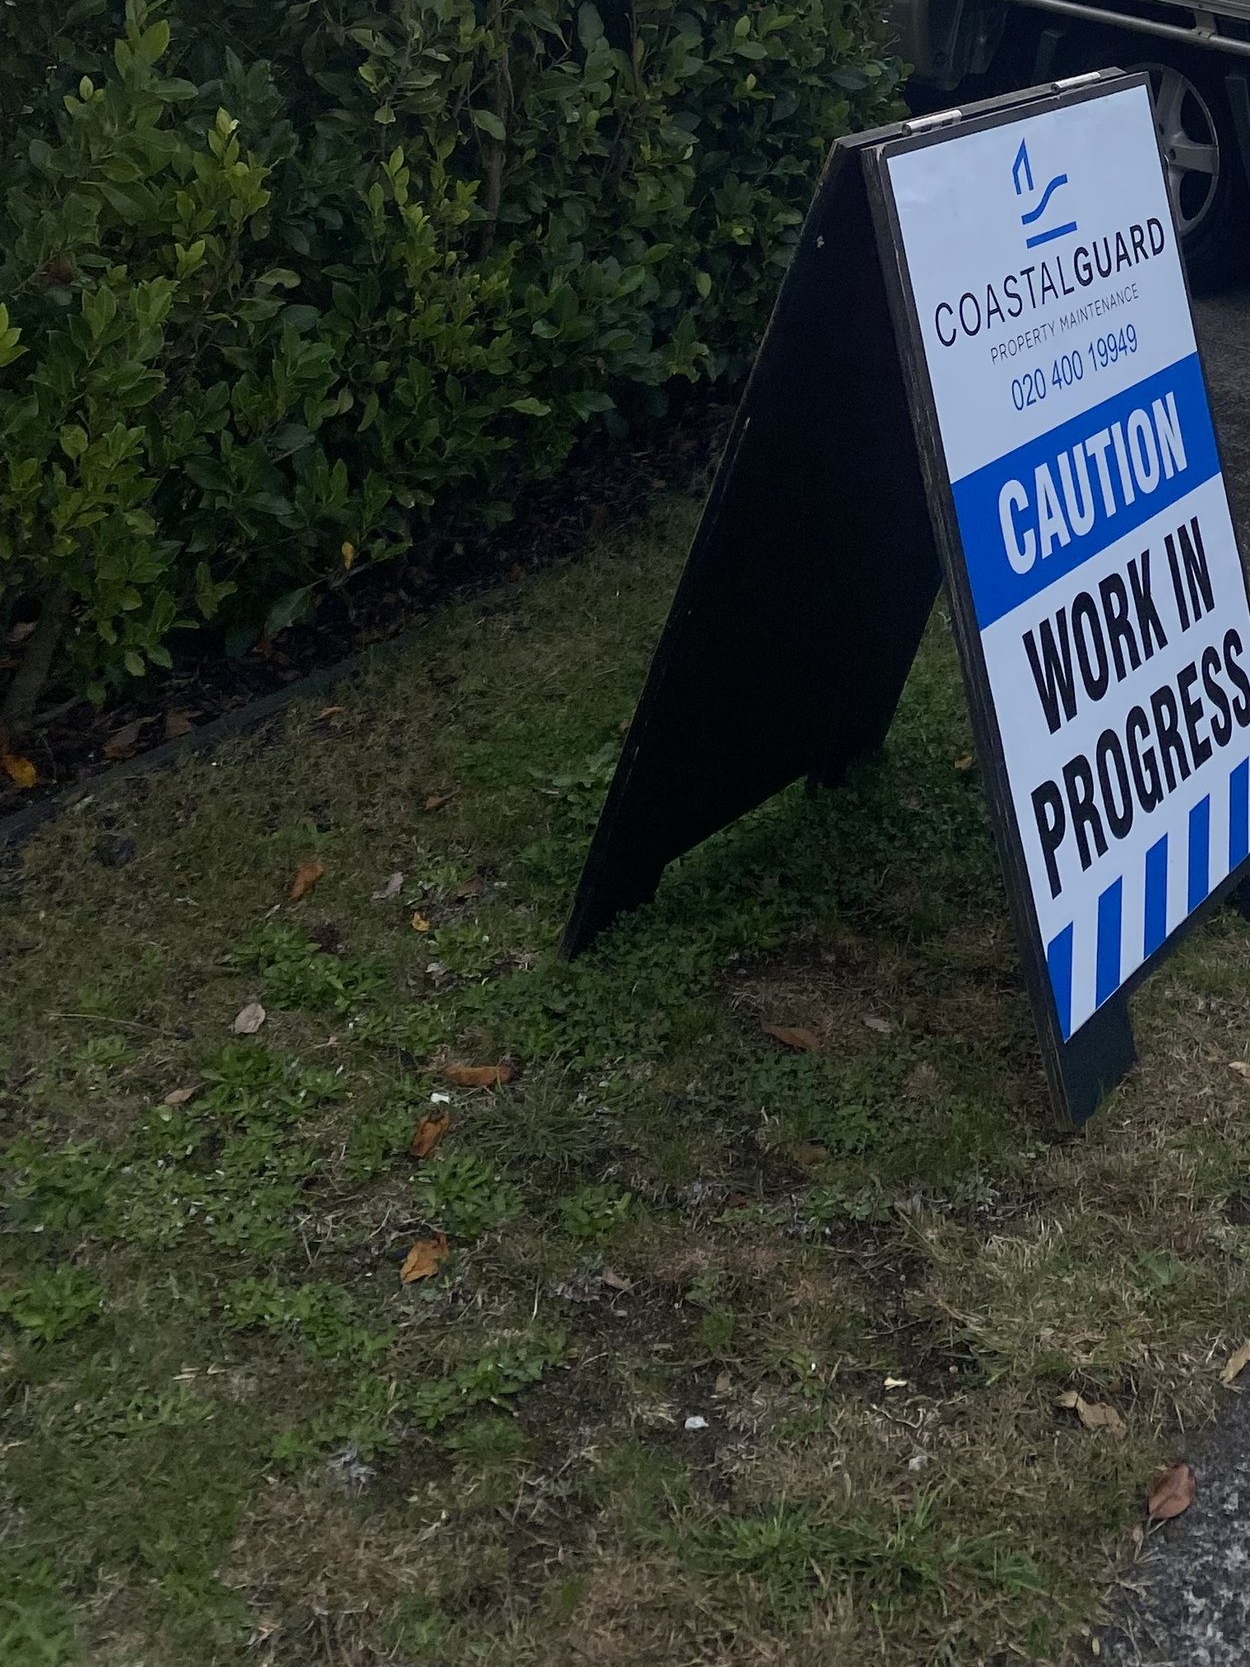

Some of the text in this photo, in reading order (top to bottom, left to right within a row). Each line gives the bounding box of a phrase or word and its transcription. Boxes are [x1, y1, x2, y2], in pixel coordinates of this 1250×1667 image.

[934, 217, 1166, 347] COASTALGUARD
[990, 283, 1139, 365] PROPERTY MAINTENANCE
[1011, 323, 1138, 411] 020 400 19949
[998, 391, 1188, 574] CAUTION
[1021, 516, 1216, 735] WORK IN
